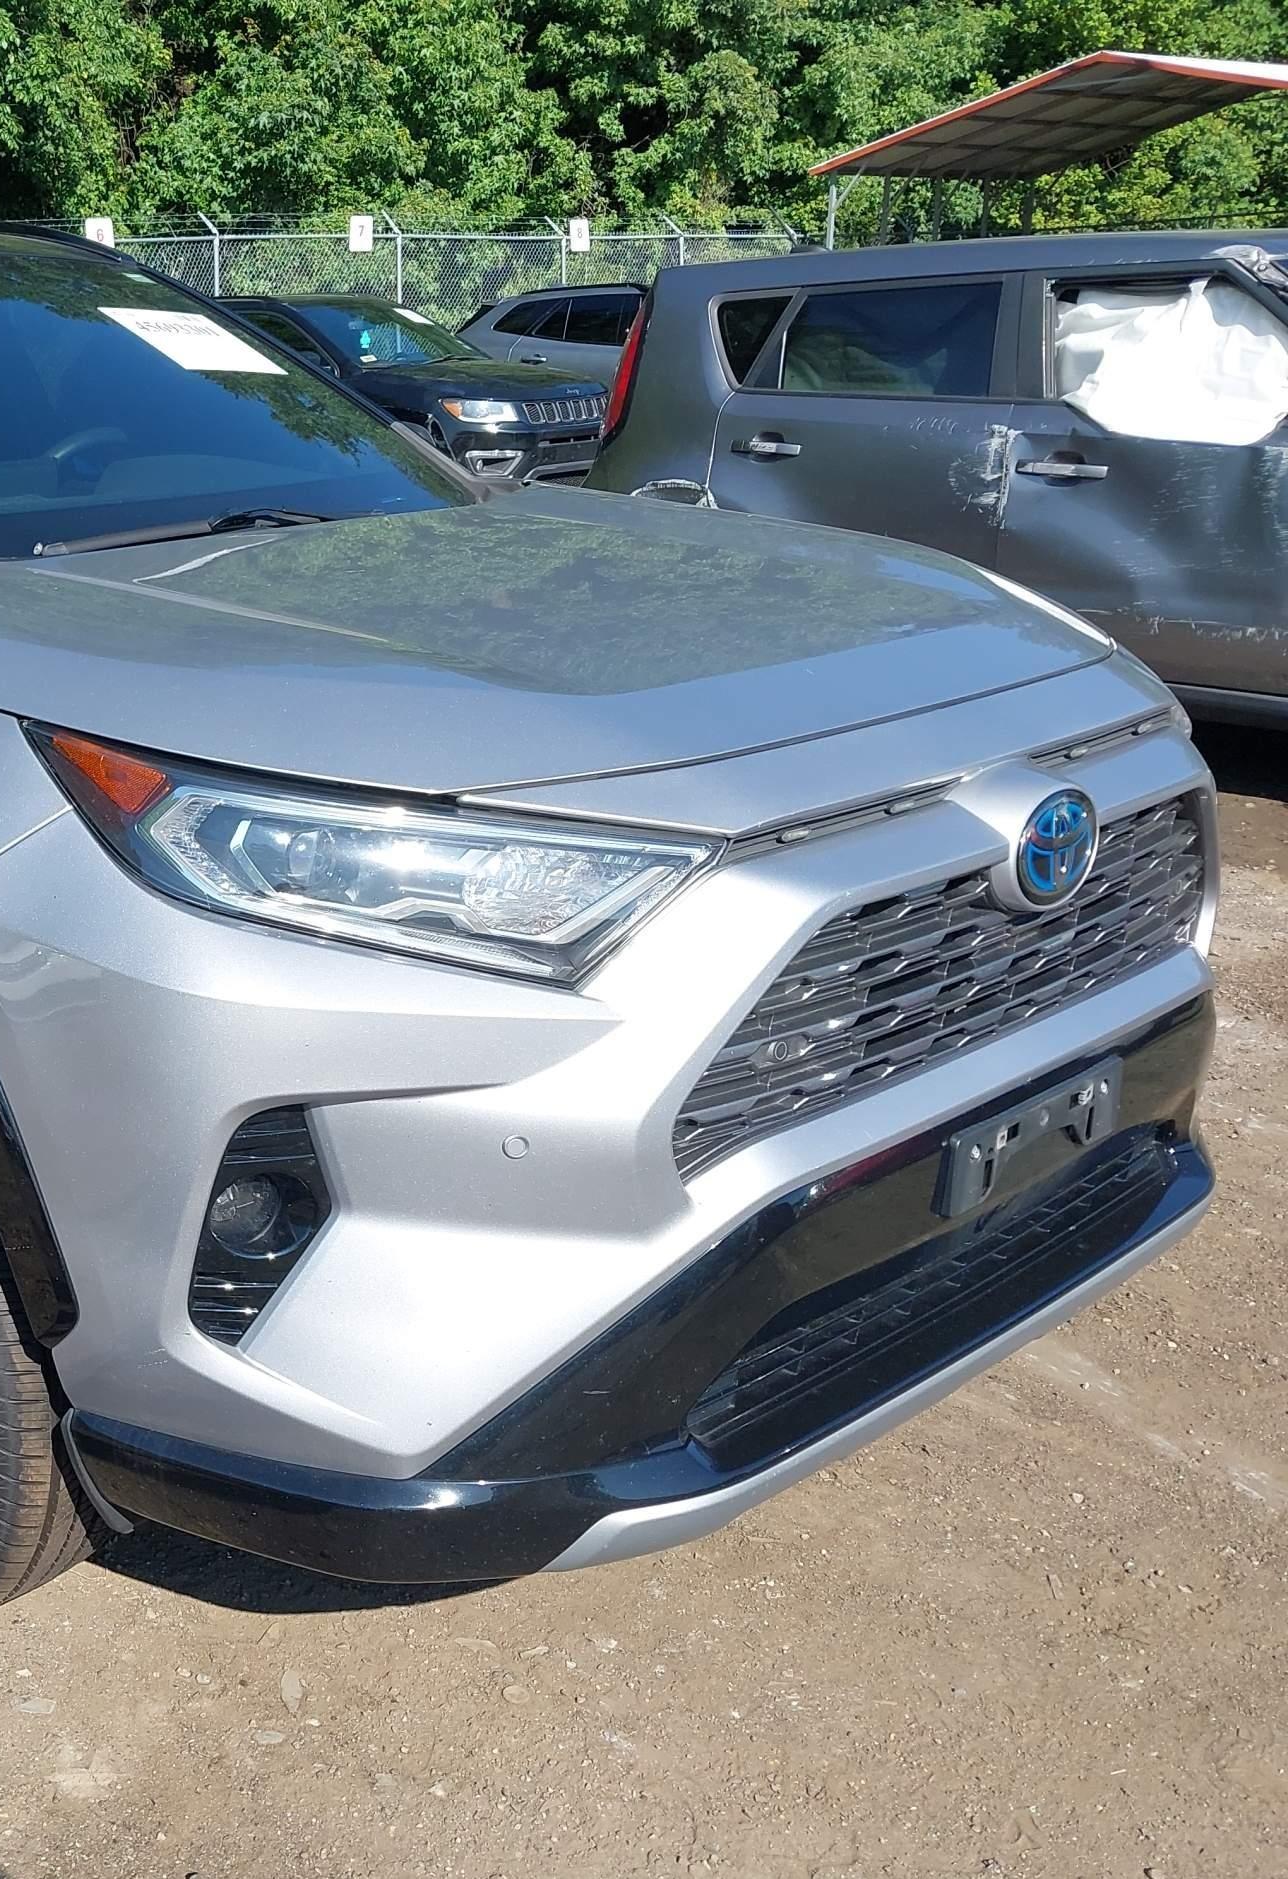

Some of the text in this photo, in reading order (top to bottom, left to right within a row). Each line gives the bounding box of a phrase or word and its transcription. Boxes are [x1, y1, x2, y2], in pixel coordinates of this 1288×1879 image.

[96, 228, 105, 242] 6
[358, 224, 365, 237] 7
[577, 227, 583, 239] 8
